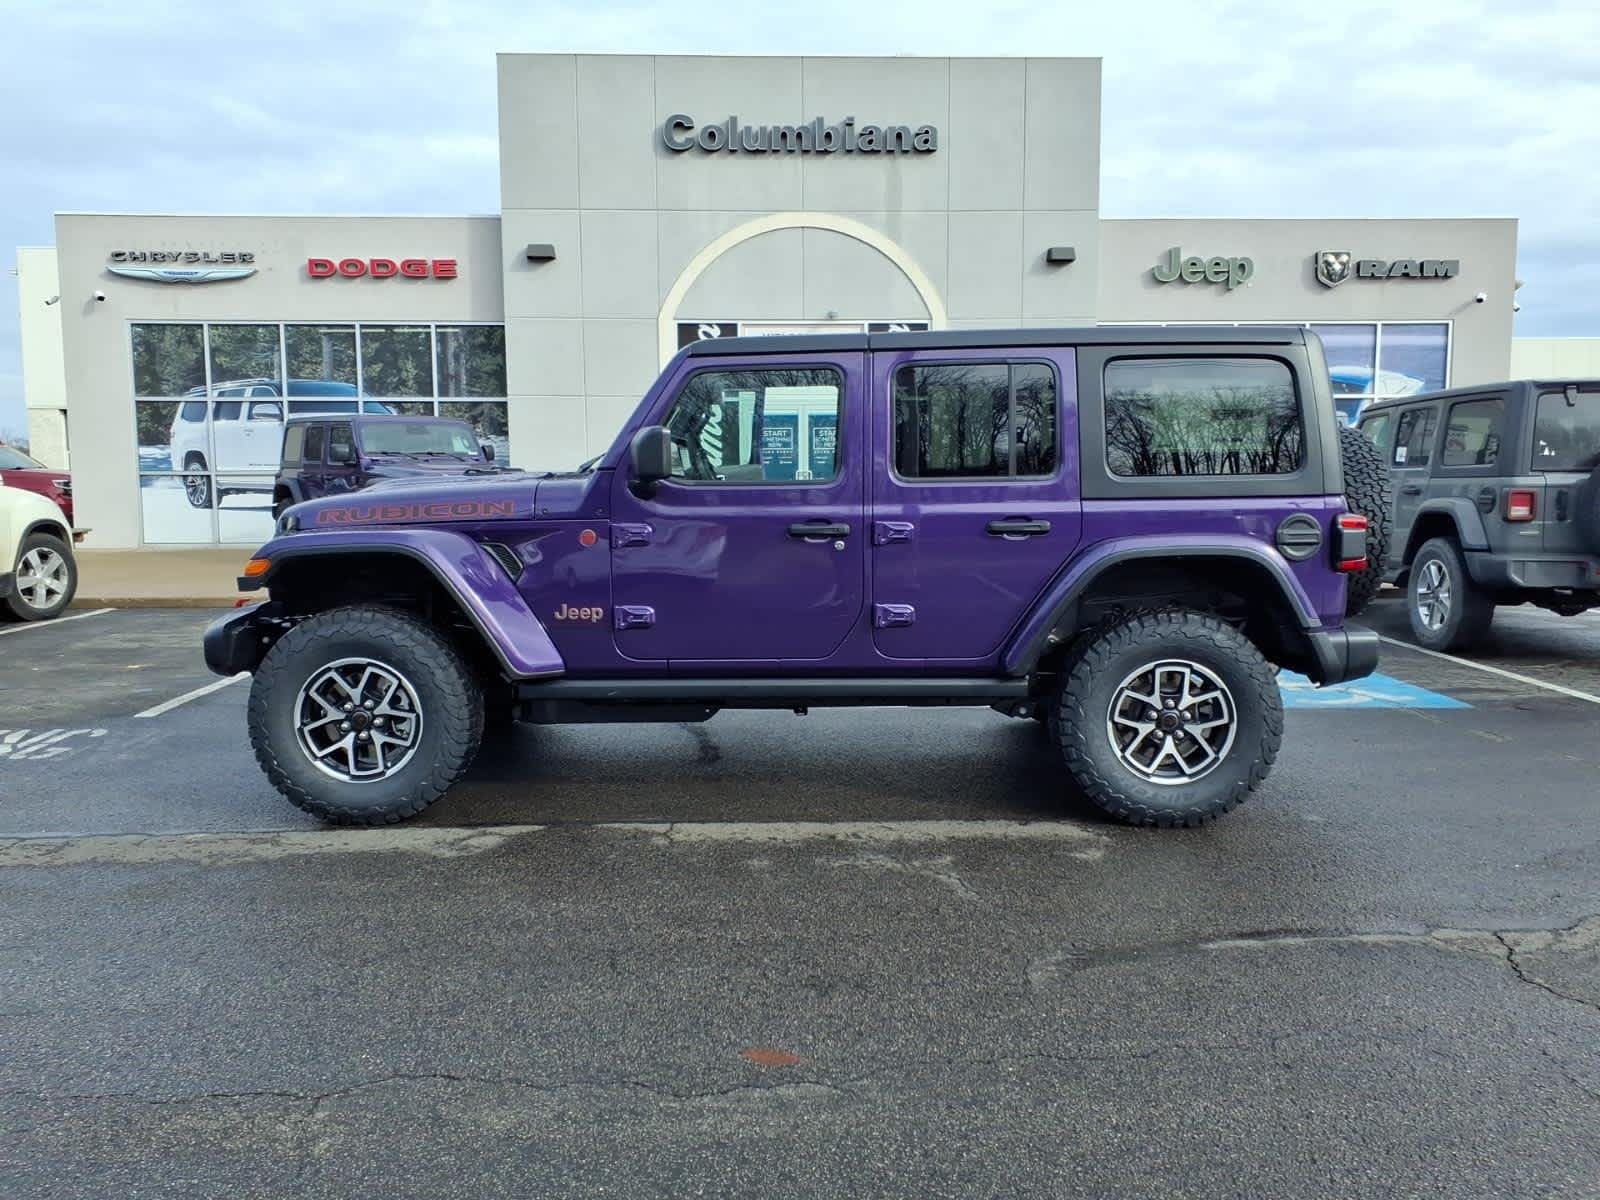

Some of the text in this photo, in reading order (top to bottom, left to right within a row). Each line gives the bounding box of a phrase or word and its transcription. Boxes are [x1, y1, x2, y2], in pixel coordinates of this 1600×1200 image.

[662, 113, 938, 153] Columbiana
[110, 250, 256, 264] CHRYSLER
[307, 257, 458, 278] DODGE
[1152, 246, 1254, 290] Jeep
[1356, 259, 1460, 279] RAM
[316, 501, 515, 525] RUBICON
[554, 603, 604, 623] Jeep
